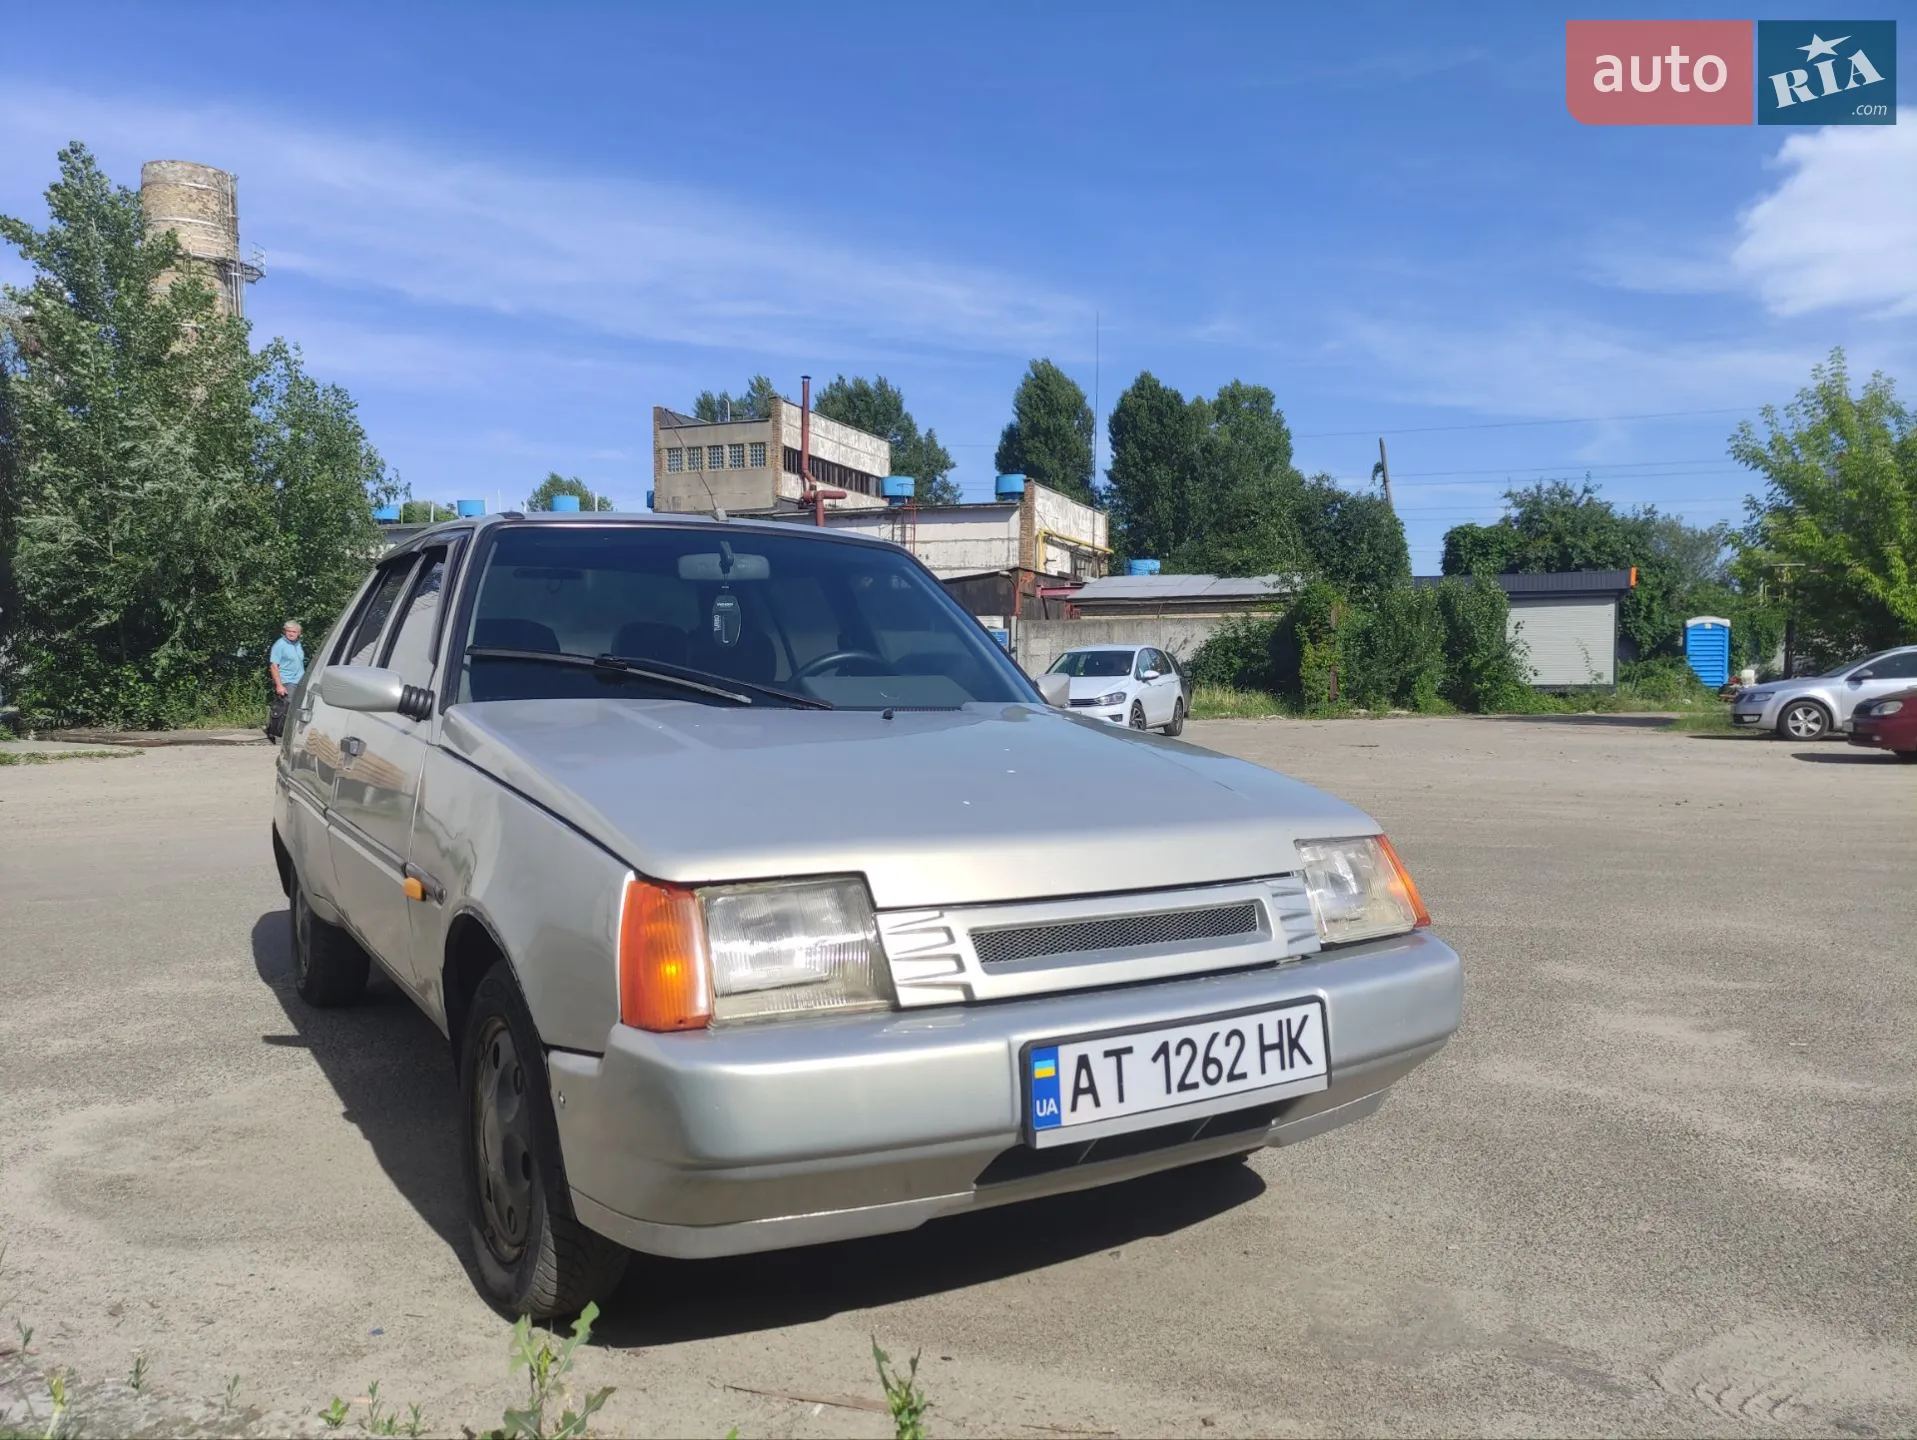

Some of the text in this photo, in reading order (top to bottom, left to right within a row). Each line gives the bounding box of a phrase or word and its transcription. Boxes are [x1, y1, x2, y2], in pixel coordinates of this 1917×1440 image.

[1070, 1014, 1313, 1112] AT 1262 HK
[1036, 1098, 1059, 1117] UA
